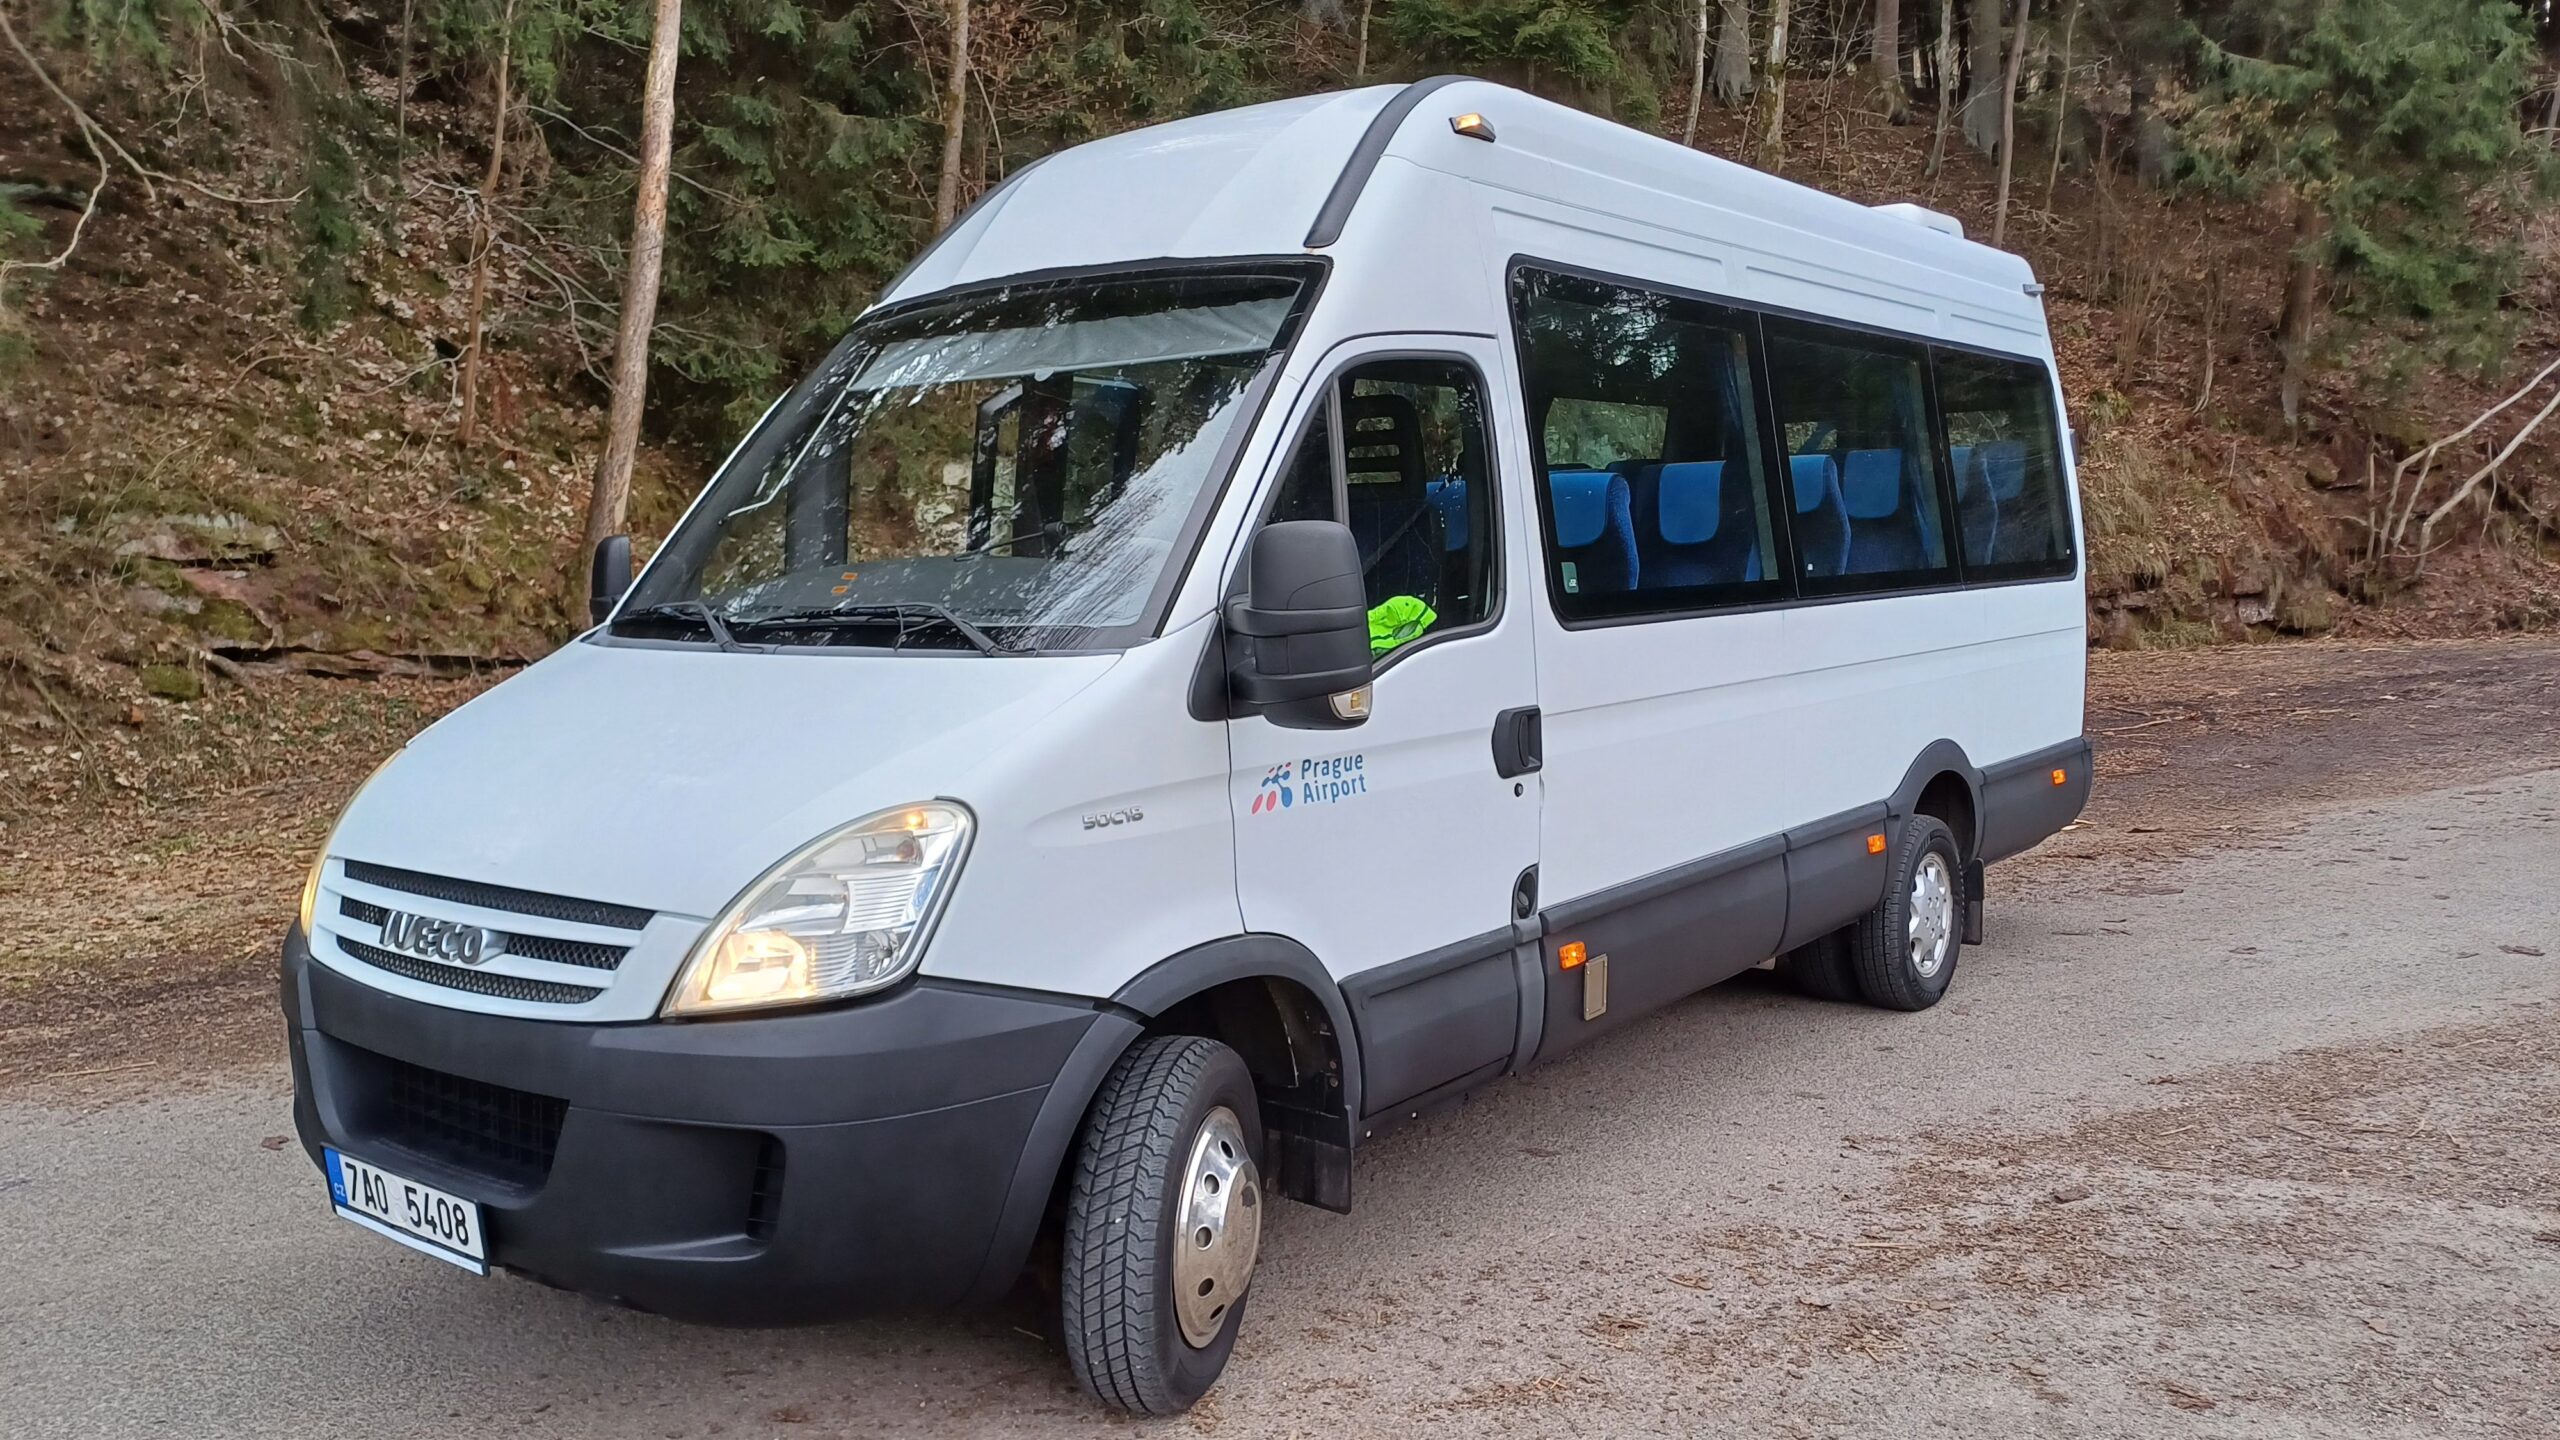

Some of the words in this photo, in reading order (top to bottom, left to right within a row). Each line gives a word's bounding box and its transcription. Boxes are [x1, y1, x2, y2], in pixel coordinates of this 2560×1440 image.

[1302, 754, 1363, 780] Prague
[1303, 774, 1366, 804] Airport
[379, 909, 482, 965] IVECO
[334, 1182, 345, 1197] CZ
[345, 1162, 389, 1215] 7A0
[404, 1185, 469, 1246] 5408
